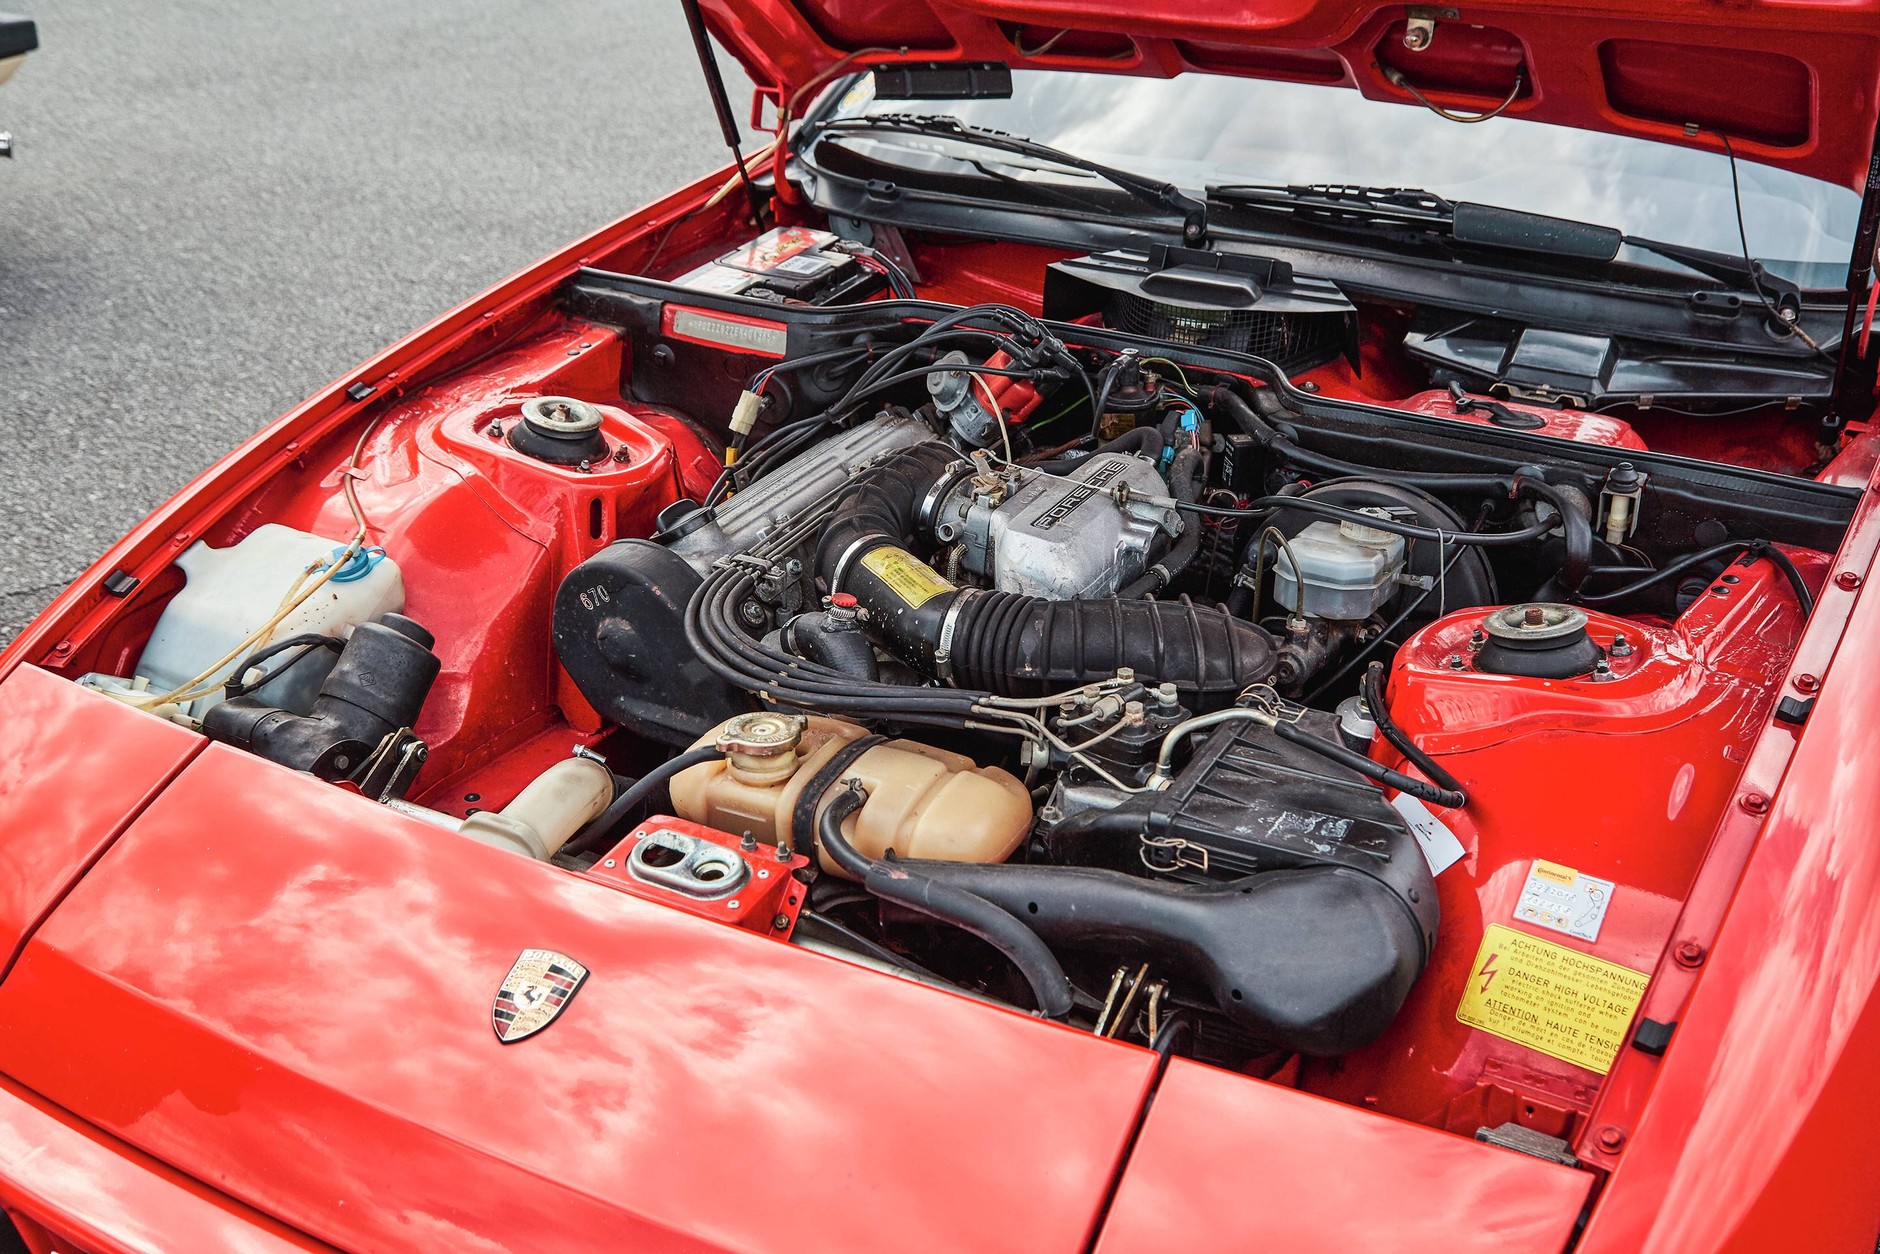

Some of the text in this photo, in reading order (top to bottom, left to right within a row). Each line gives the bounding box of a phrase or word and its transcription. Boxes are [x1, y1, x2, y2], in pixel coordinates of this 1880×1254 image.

[1034, 460, 1125, 529] PORSCHE
[580, 584, 610, 610] 670
[1537, 867, 1568, 880] Continental
[1510, 939, 1647, 991] ACHTUNG HOCHSPANNUNG
[1510, 956, 1523, 964] und
[1526, 960, 1582, 983] Drehzahlmesser
[1512, 949, 1544, 963] Arbeiten
[1558, 964, 1569, 972] der
[1501, 990, 1540, 1007] tachometer
[1574, 1017, 1587, 1025] can
[1504, 984, 1532, 998] working
[1547, 999, 1575, 1013] ignition
[1578, 1010, 1591, 1019] and
[1508, 967, 1629, 1016] DANGER HIGH VOLTAGE
[1512, 979, 1618, 1020] electric shock suffered when
[1489, 1009, 1514, 1021] Danger
[1530, 1024, 1546, 1034] mort
[1562, 1036, 1573, 1044] cas
[1489, 1017, 1500, 1025] sur
[1511, 1025, 1543, 1040] allumage
[1591, 1054, 1610, 1065] tours
[1546, 1019, 1580, 1038] HAUTE
